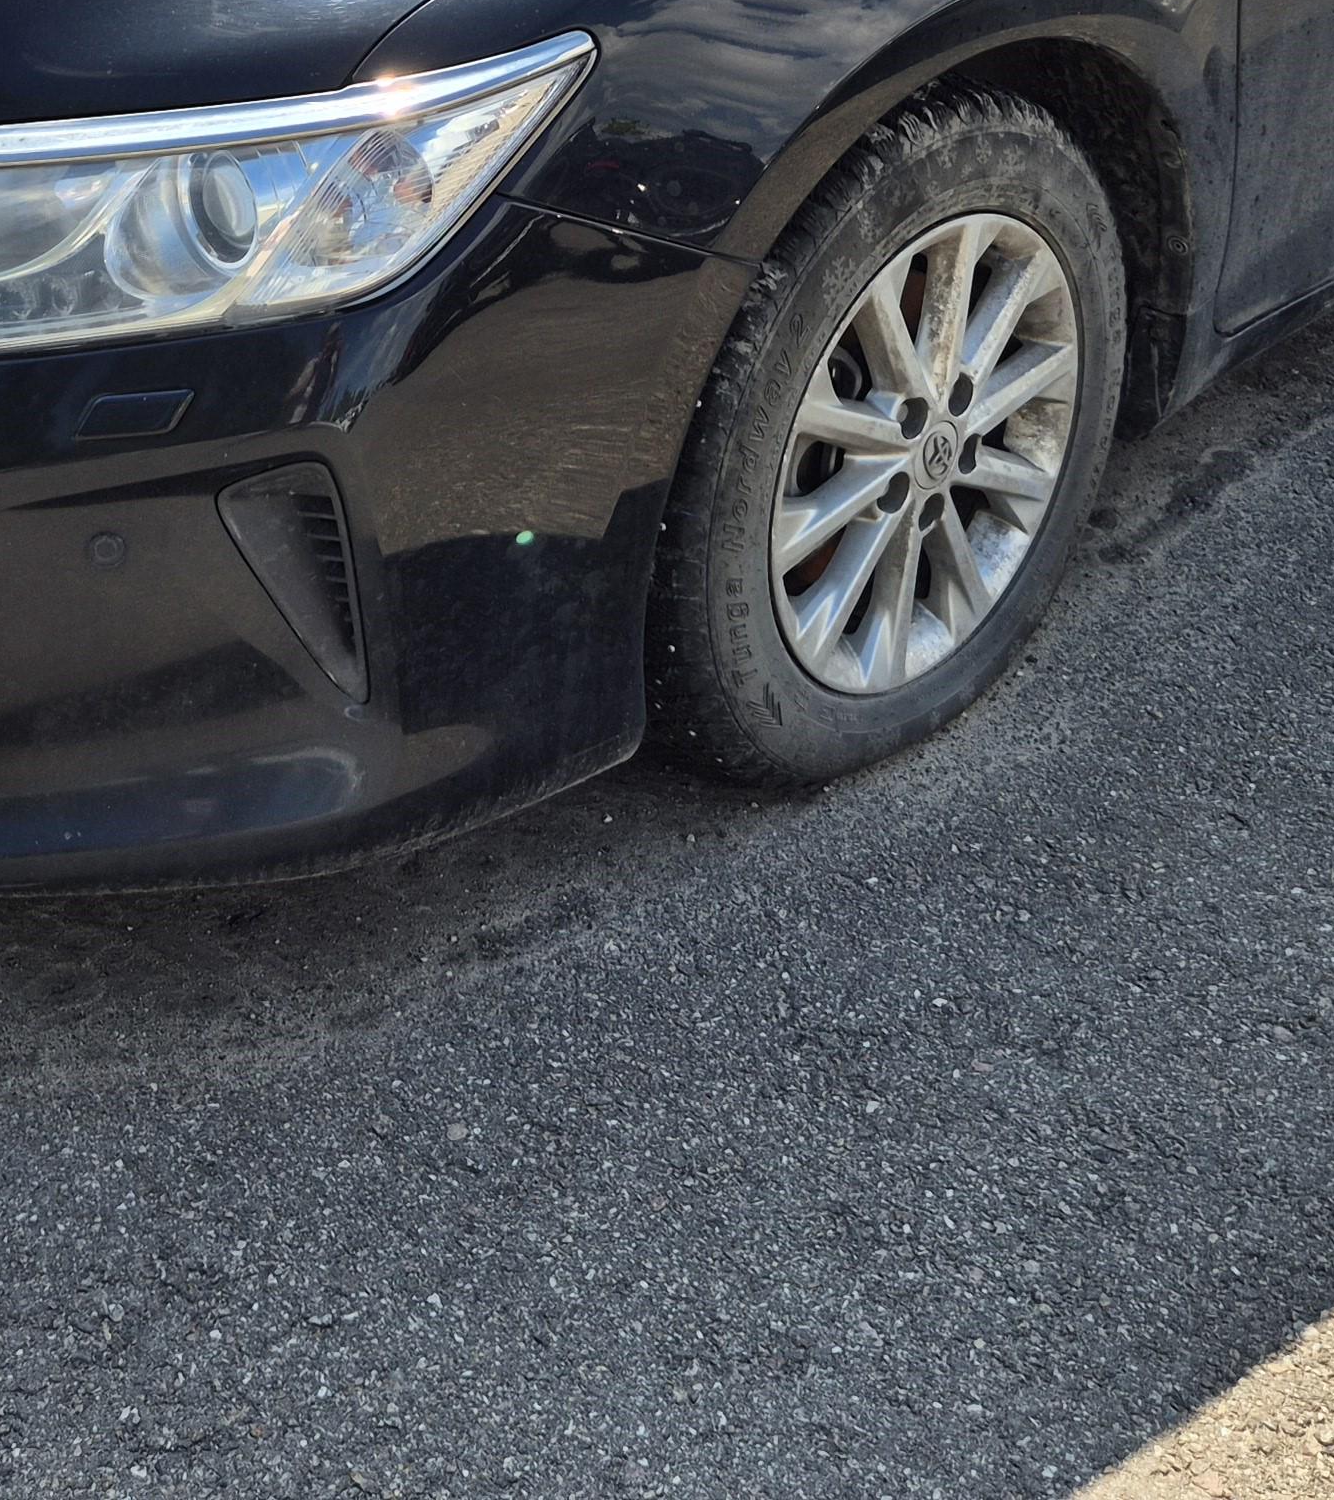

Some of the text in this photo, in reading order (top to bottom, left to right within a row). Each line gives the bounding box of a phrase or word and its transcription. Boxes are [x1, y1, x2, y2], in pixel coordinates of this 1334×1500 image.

[722, 313, 813, 690] Tunga Nordway 2
